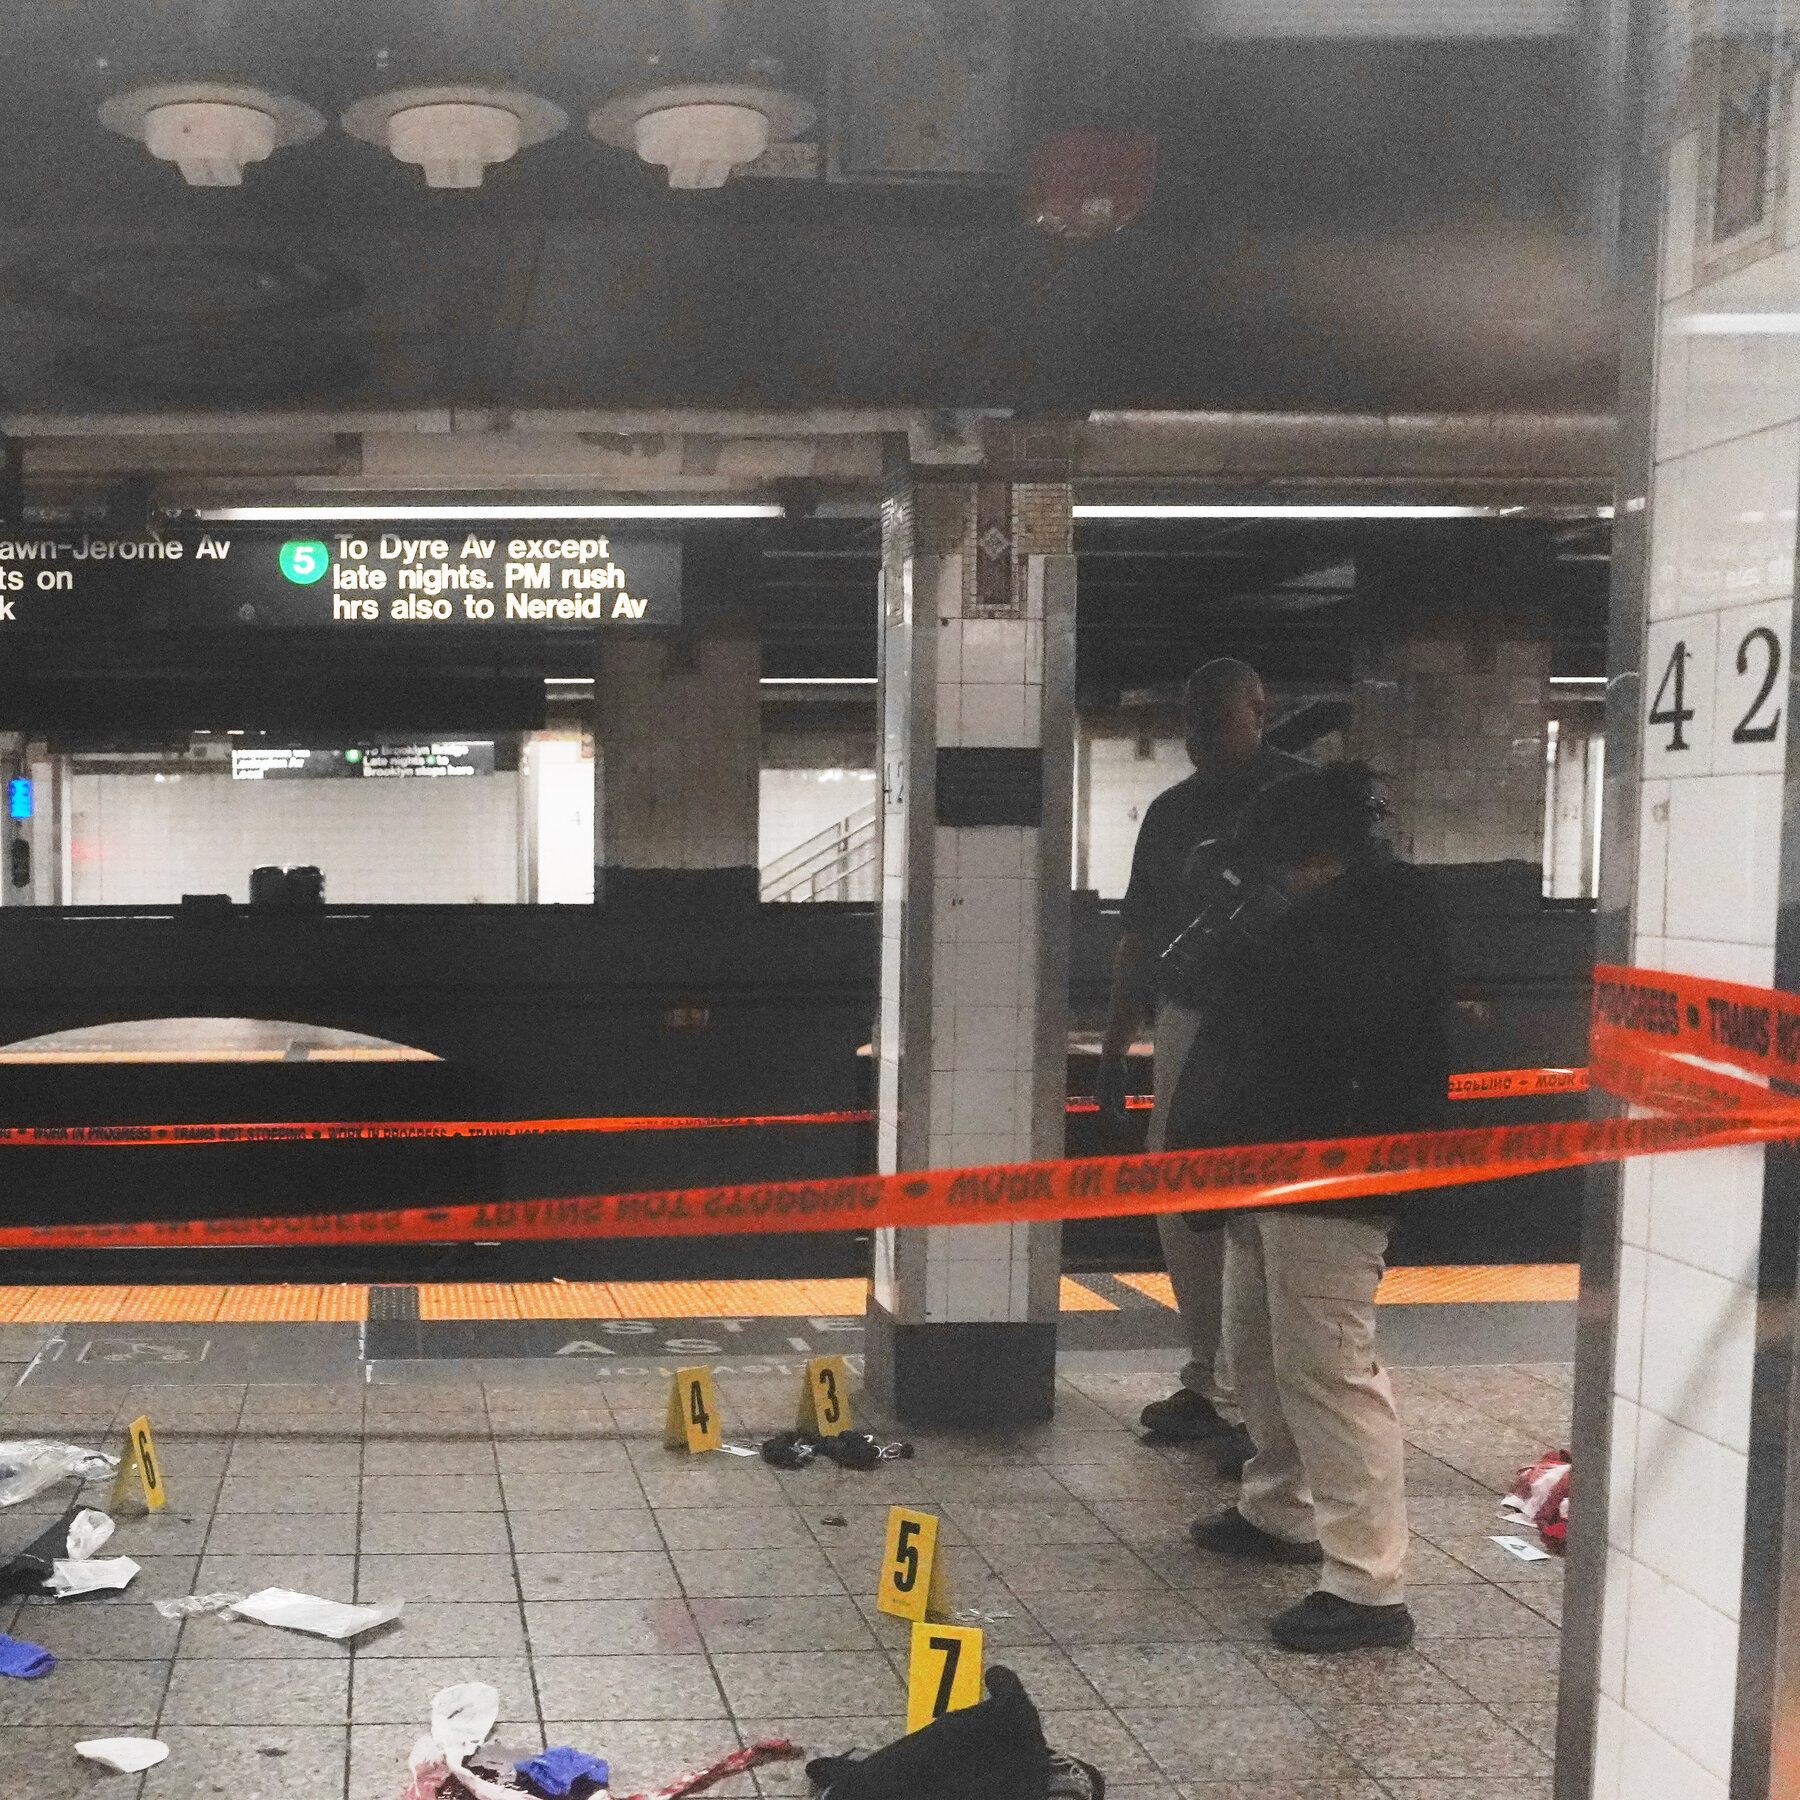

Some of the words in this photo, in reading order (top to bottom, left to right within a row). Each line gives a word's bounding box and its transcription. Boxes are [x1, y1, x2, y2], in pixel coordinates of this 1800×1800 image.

[195, 534, 231, 560] Av
[292, 546, 317, 574] 5
[333, 534, 369, 560] To
[379, 533, 449, 567] Dyre
[460, 534, 496, 560] Av
[507, 535, 610, 565] except
[37, 570, 73, 591] on
[333, 563, 387, 590] late
[399, 562, 494, 596] nights.
[505, 562, 552, 589] PM
[561, 562, 627, 589] rush
[333, 593, 379, 620] hrs
[390, 593, 453, 620] also
[463, 595, 495, 620] to
[506, 592, 601, 620] Nereid
[611, 593, 648, 620] Av
[691, 1380, 710, 1434] 4
[820, 1369, 840, 1424] 3
[138, 1430, 156, 1490] 6
[893, 1520, 921, 1593] 5
[929, 1636, 962, 1719] 7
